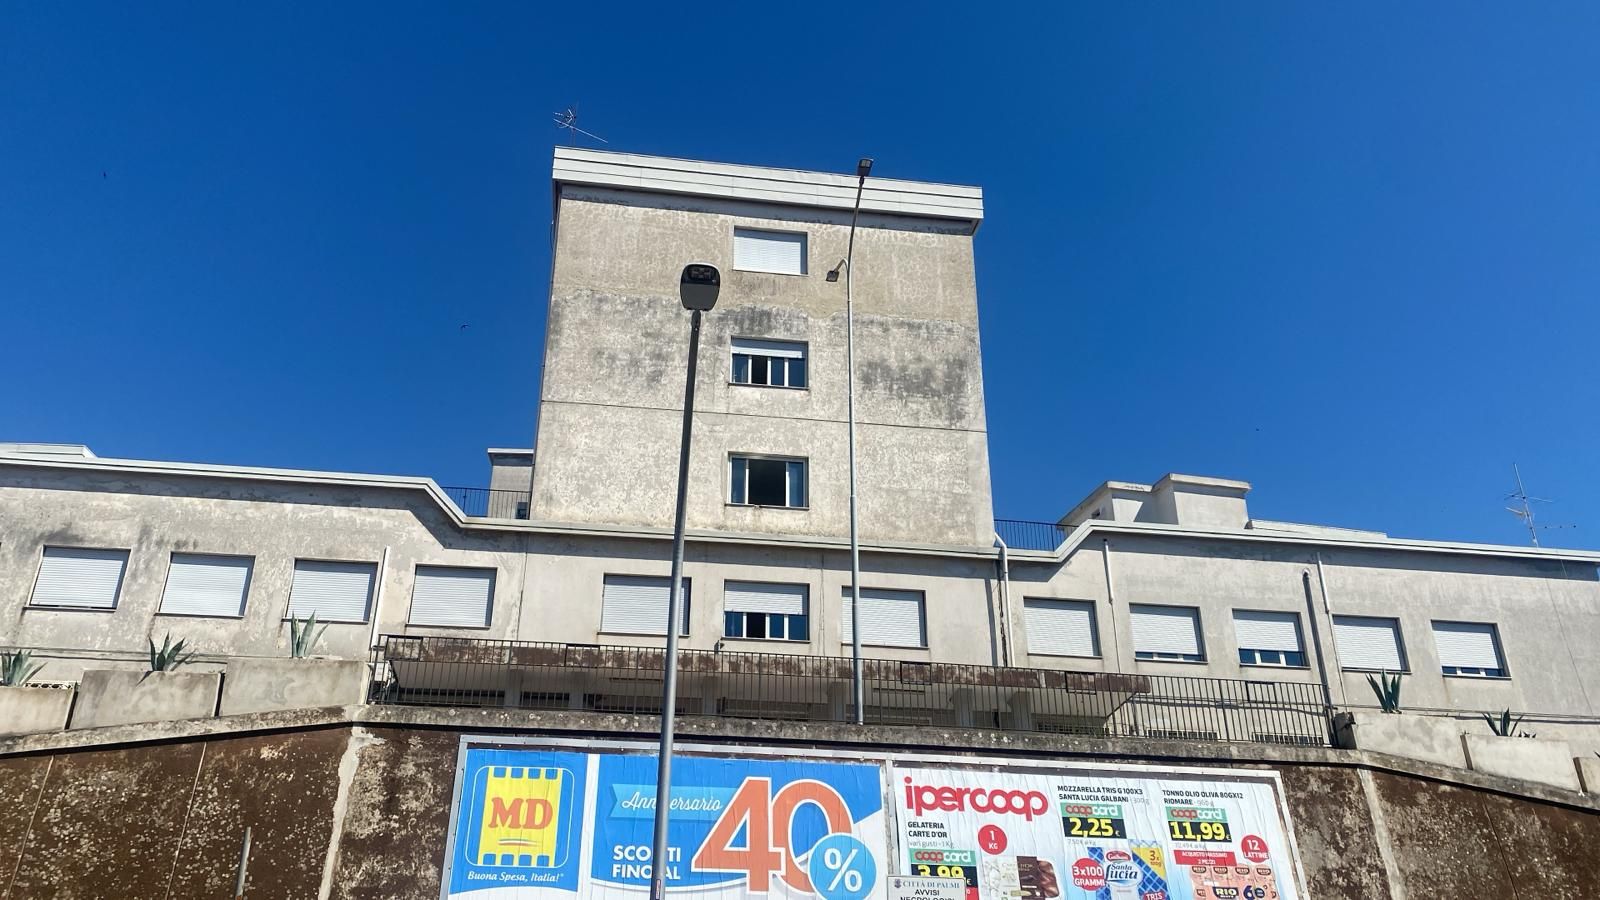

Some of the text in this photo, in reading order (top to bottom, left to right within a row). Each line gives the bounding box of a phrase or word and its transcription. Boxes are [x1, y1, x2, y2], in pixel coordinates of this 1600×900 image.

[1057, 785, 1101, 793] MOZZARELLA
[622, 792, 723, 811] Annersario
[904, 776, 1049, 821] ipercoop
[488, 797, 553, 829] MD
[907, 821, 944, 829] GELATERIA
[1069, 817, 1114, 837] 2,25
[1170, 821, 1226, 841] 11,99
[691, 777, 854, 895] 40
[908, 830, 930, 838] CARTE
[989, 830, 995, 840] 1
[1247, 840, 1260, 850] 12
[613, 845, 681, 862] SCOTI
[468, 871, 559, 882] Buona Spesa, Italia!
[612, 864, 653, 879] FINO
[917, 865, 964, 877] 399
[1073, 866, 1103, 875] 3x100
[1146, 892, 1163, 900] TRIS
